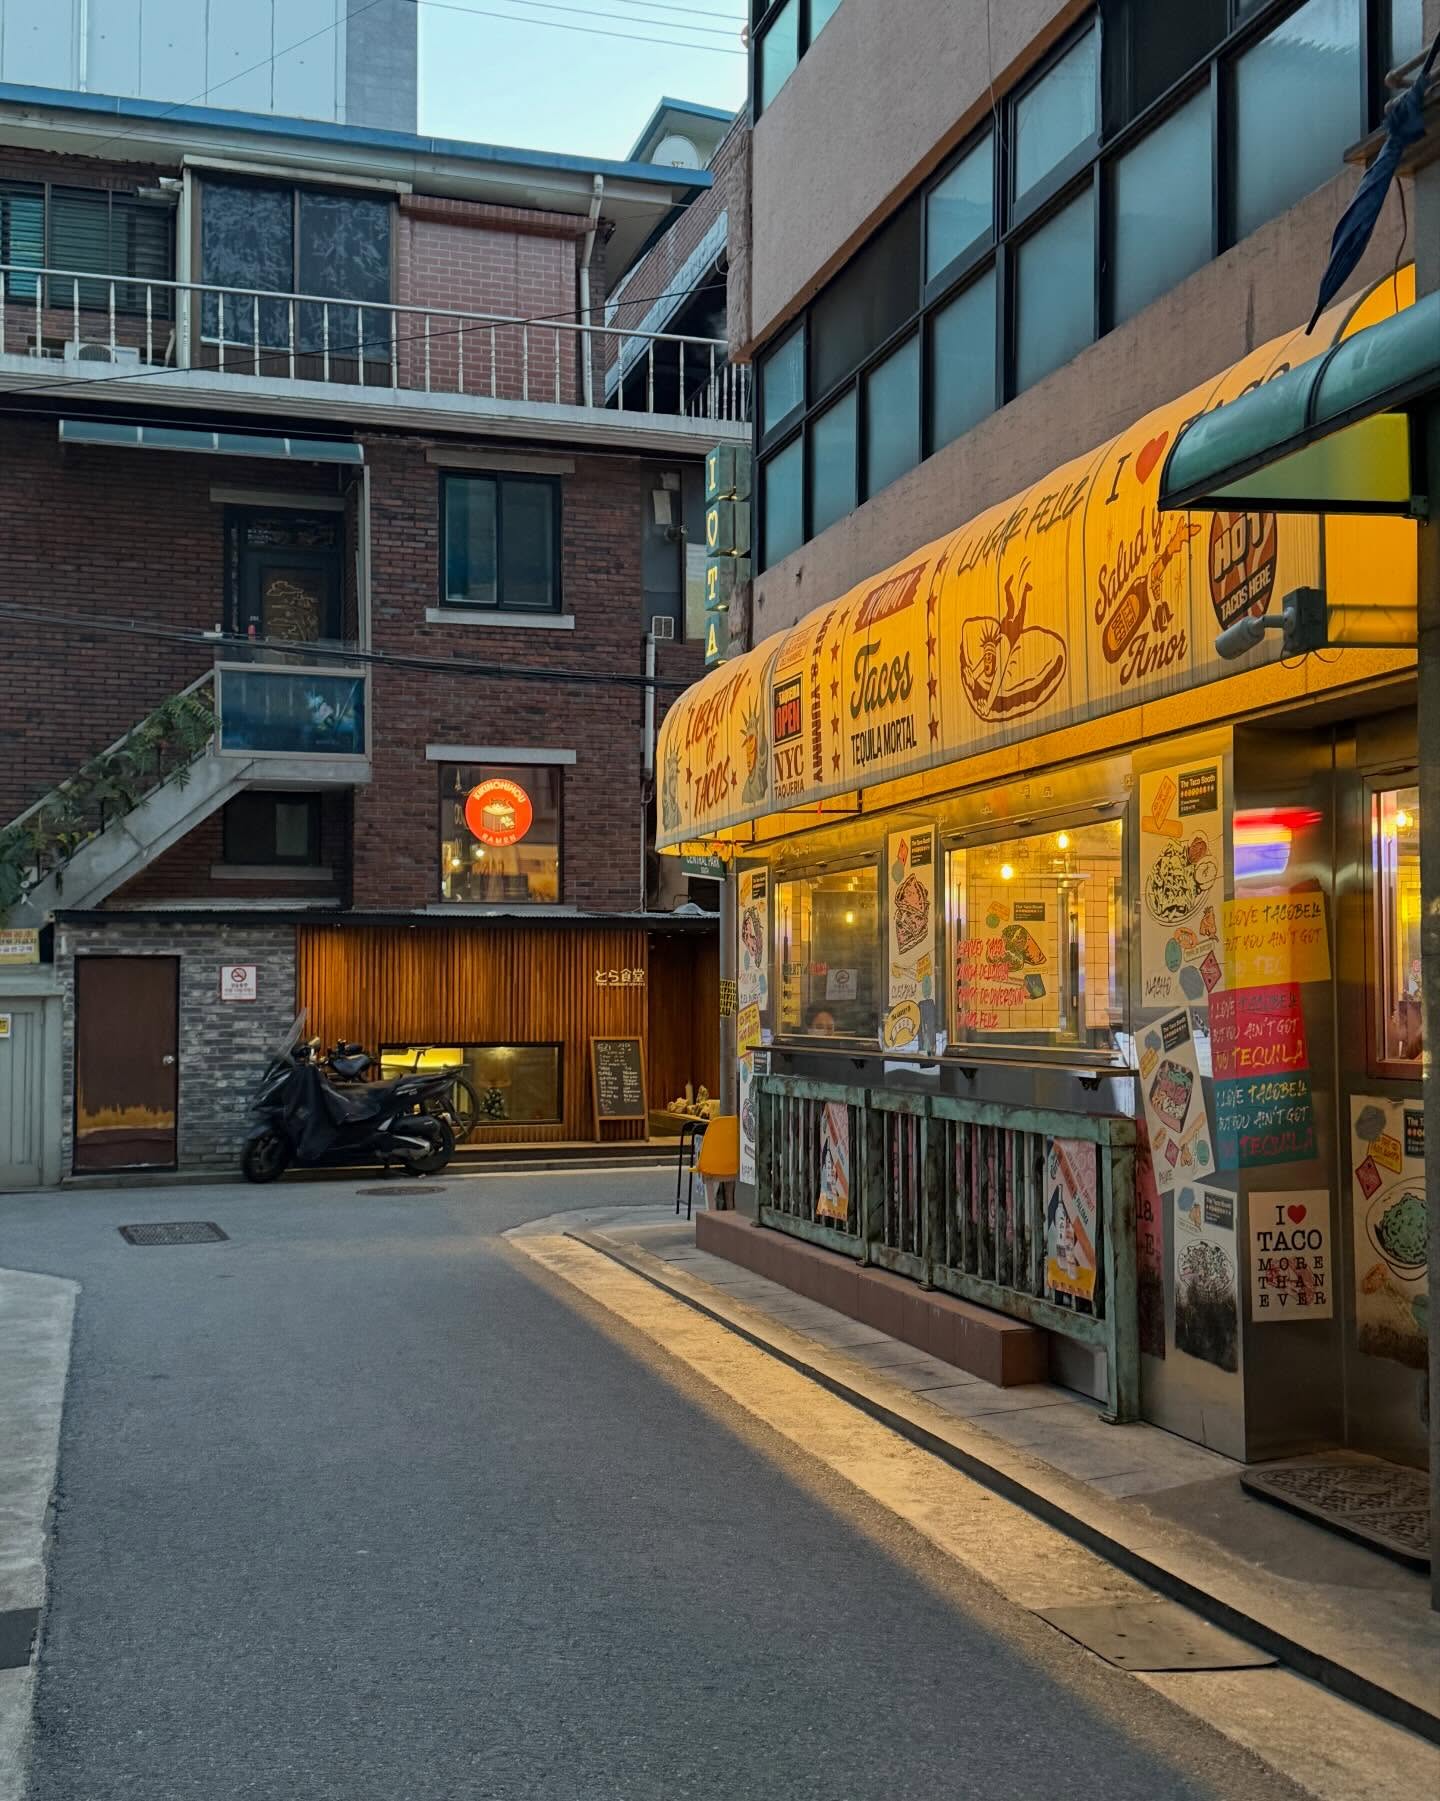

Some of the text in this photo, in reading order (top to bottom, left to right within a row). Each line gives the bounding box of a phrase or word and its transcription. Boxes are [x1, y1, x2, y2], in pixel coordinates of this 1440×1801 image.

[1105, 452, 1132, 505] I
[958, 507, 1028, 577] LUGAR
[1094, 505, 1149, 626] Salud
[1221, 565, 1271, 621] TACOS HERE
[1119, 629, 1188, 686] Amor
[850, 637, 914, 720] Tacos
[775, 700, 800, 738] OPEN
[811, 684, 823, 783] YUMMY
[850, 713, 918, 768] TEQUILA MORTAL
[773, 744, 804, 784] NYC
[694, 753, 731, 818] TACOS
[774, 779, 805, 800] TAQUERIA
[595, 968, 645, 983] とら食堂
[1277, 1018, 1298, 1035] GOT
[1232, 1040, 1303, 1068] TEQUILA
[1287, 1106, 1310, 1124] GOT
[1275, 1205, 1286, 1225] I
[1257, 1229, 1323, 1252] TACO
[1258, 1256, 1325, 1271] MORE
[1258, 1274, 1326, 1289] THAN
[1259, 1292, 1327, 1308] EVER
